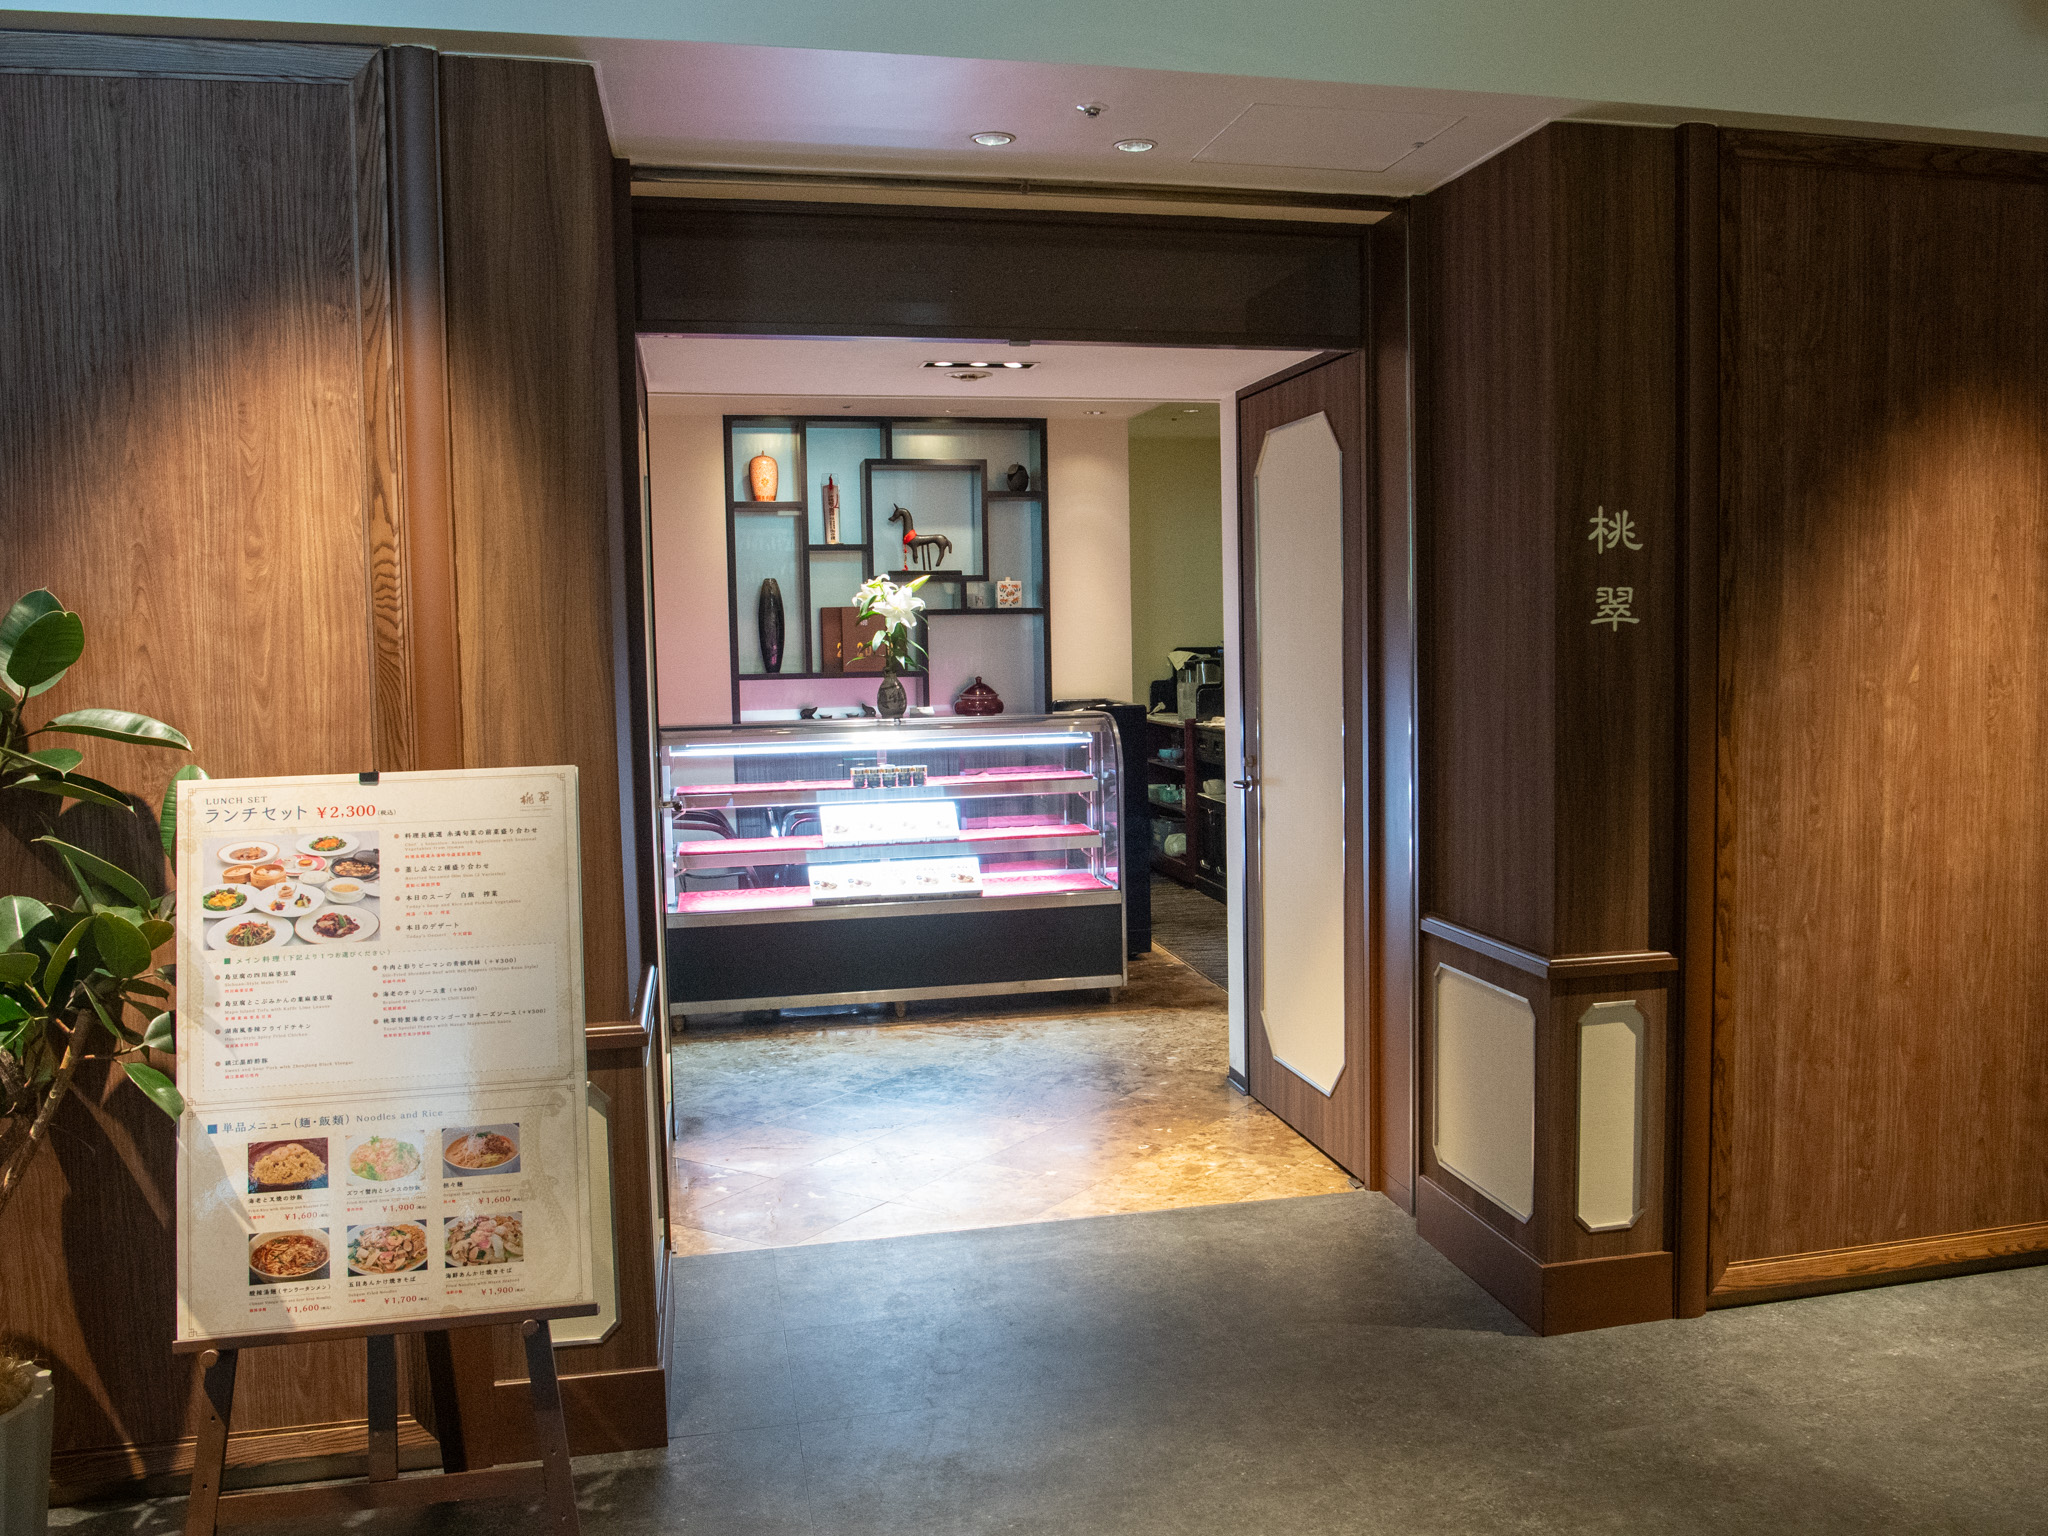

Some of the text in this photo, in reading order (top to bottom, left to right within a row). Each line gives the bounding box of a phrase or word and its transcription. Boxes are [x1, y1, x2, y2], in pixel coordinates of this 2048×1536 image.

[1588, 505, 1644, 632] 桃翠
[205, 797, 243, 805] LUNCH
[205, 806, 307, 823] ランチセット
[316, 805, 376, 819] ¥2,300
[406, 922, 459, 931] 本日のデザート
[356, 1112, 396, 1122] Noodles
[400, 1110, 418, 1119] and
[422, 1108, 442, 1117] Rice
[286, 1304, 320, 1313] ¥1,600
